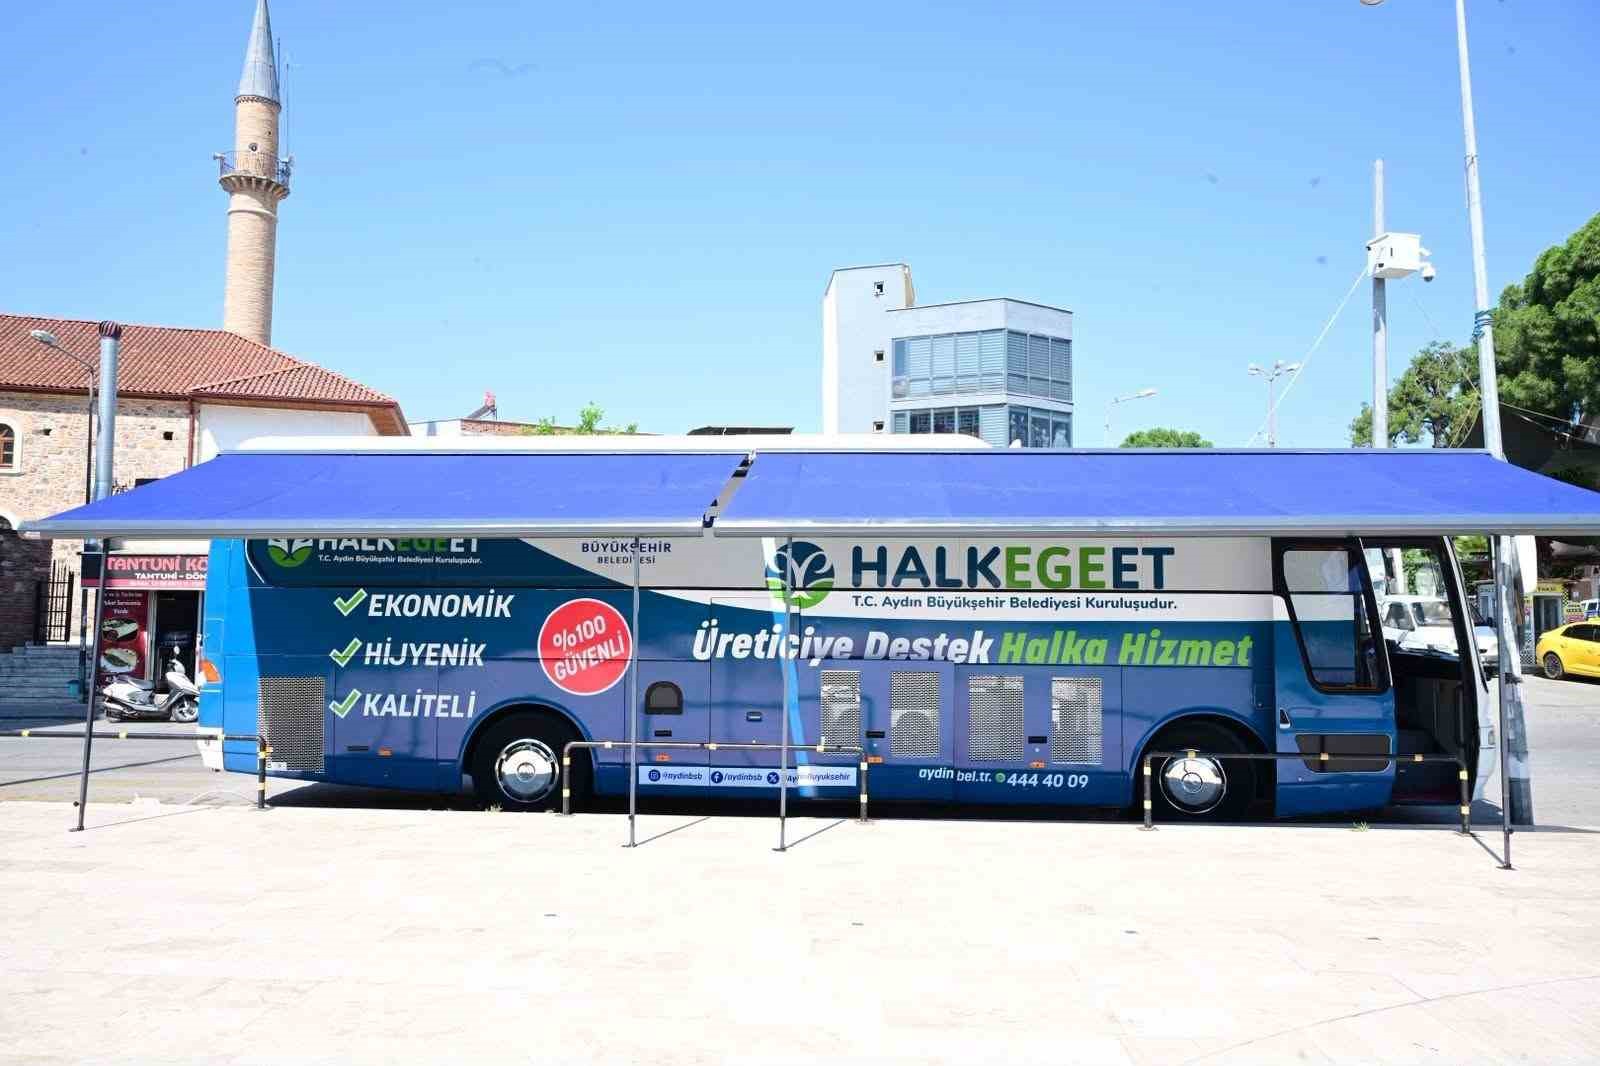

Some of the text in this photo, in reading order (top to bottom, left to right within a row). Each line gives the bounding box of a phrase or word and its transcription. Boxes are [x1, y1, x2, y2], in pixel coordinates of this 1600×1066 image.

[598, 556, 656, 564] BELEDİESİ
[852, 545, 1175, 589] HALKEGEET
[368, 588, 514, 618] EKONOMİK
[853, 595, 1177, 611] T.C. Aydın Büyükşehir Belediyesi Kuruluşudur.
[552, 615, 607, 651] %100
[692, 619, 1253, 666] Üreticiye Destek Halka Hizmet
[364, 637, 487, 667] HİJYENİK
[553, 629, 625, 681] GÜVENLİ
[363, 688, 476, 718] KALİTELİ
[1006, 773, 1038, 787] 444
[1042, 774, 1063, 787] 40
[1067, 775, 1088, 788] 09
